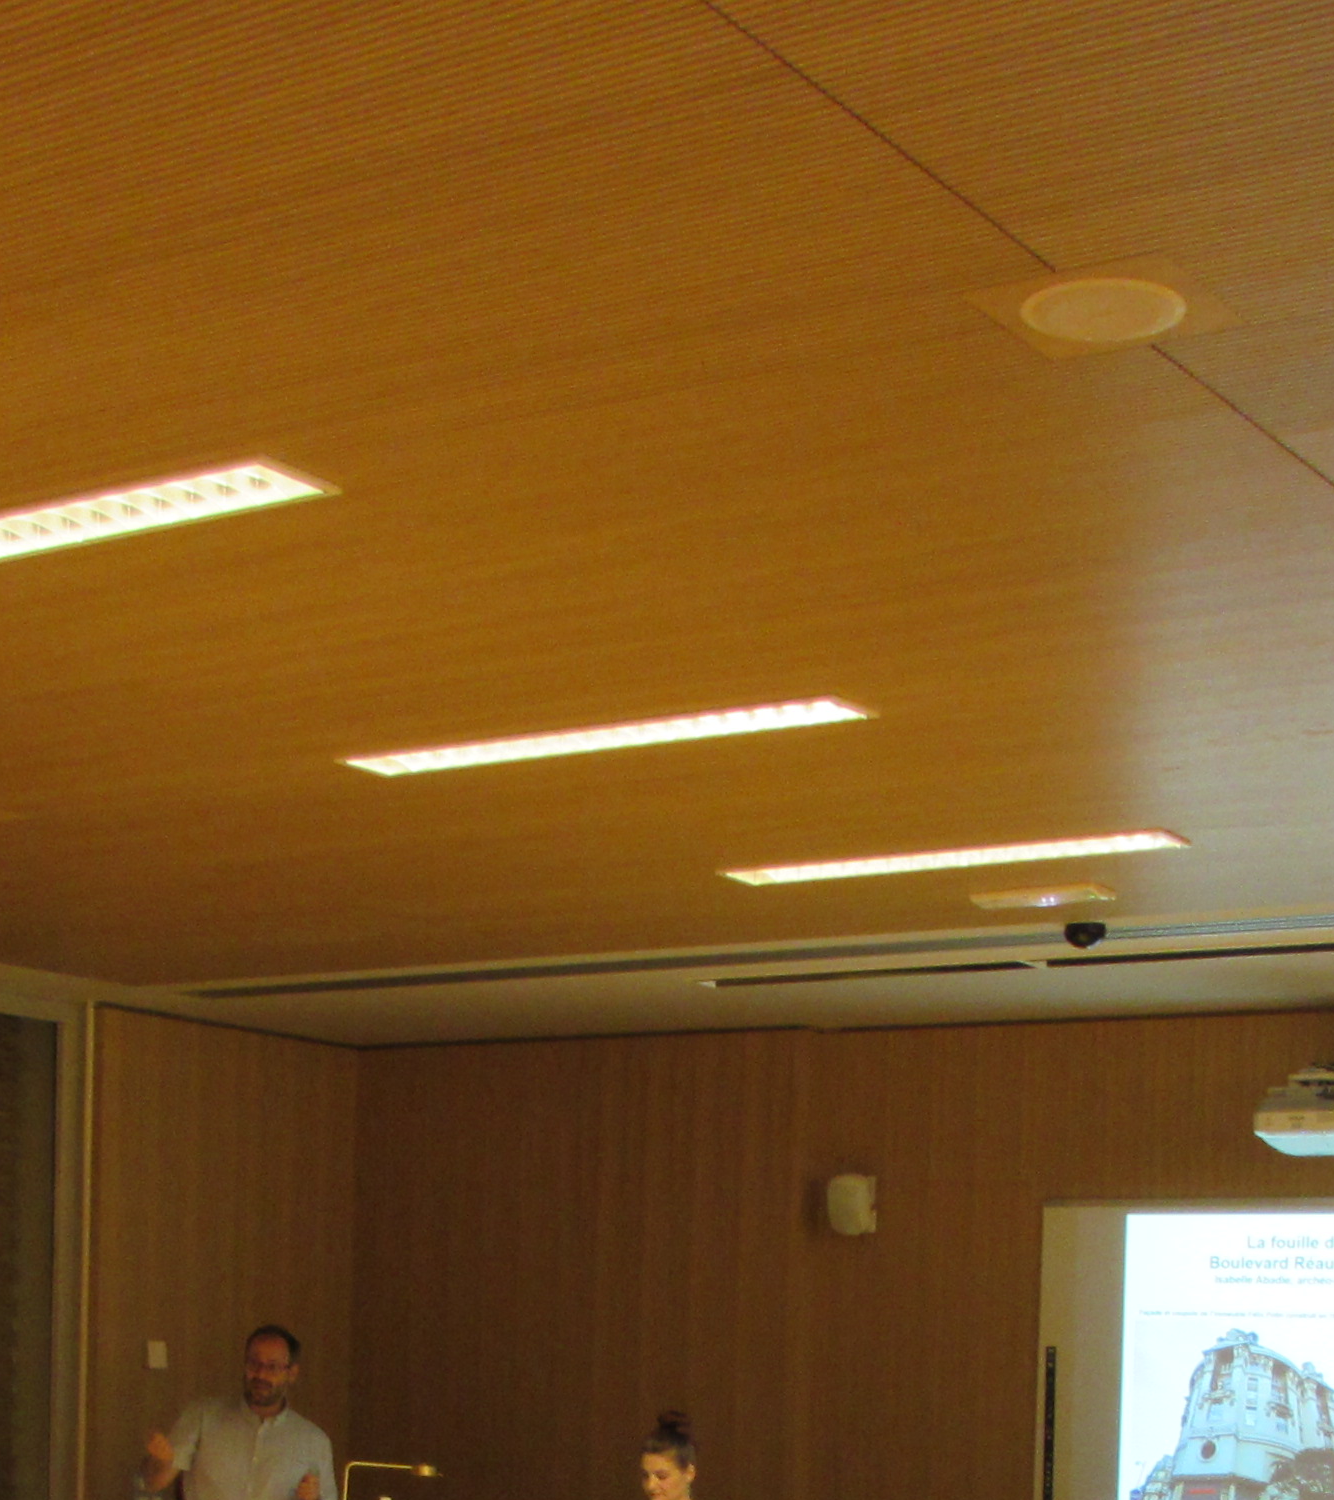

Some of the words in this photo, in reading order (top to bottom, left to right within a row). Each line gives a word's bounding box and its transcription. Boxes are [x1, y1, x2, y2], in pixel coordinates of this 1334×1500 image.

[1247, 1236, 1266, 1249] La
[1271, 1236, 1319, 1249] fouille
[1210, 1256, 1289, 1270] Boulevard
[1215, 1275, 1253, 1284] Isabelle
